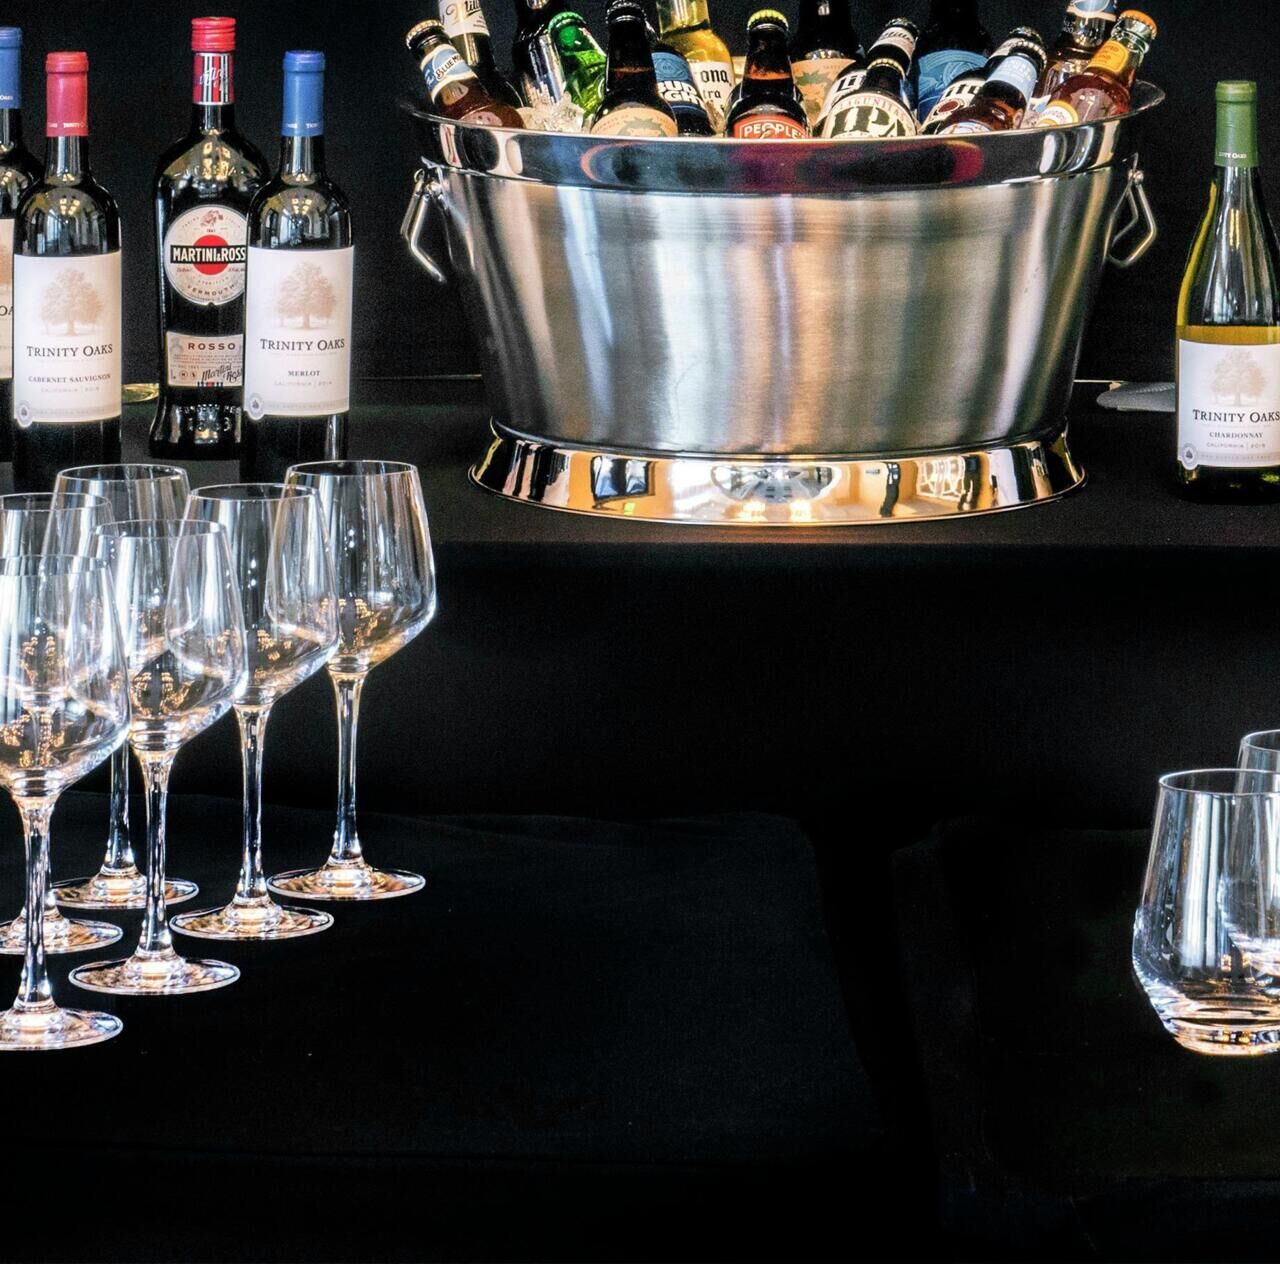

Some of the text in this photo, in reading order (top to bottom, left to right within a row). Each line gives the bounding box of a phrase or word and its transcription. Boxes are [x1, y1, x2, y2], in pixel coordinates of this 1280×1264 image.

[831, 106, 907, 137] IPA
[187, 284, 236, 296] VERMOUTH
[26, 343, 114, 358] TRINITY OAKS
[187, 342, 237, 351] ROSSO
[260, 338, 346, 351] TRINITY OAKS
[28, 373, 112, 383] CABERNET SAUVIGNON
[287, 369, 321, 377] MERLOT
[1192, 408, 1280, 424] TRINITY OAKS
[1209, 431, 1264, 439] CHARDONNAY
